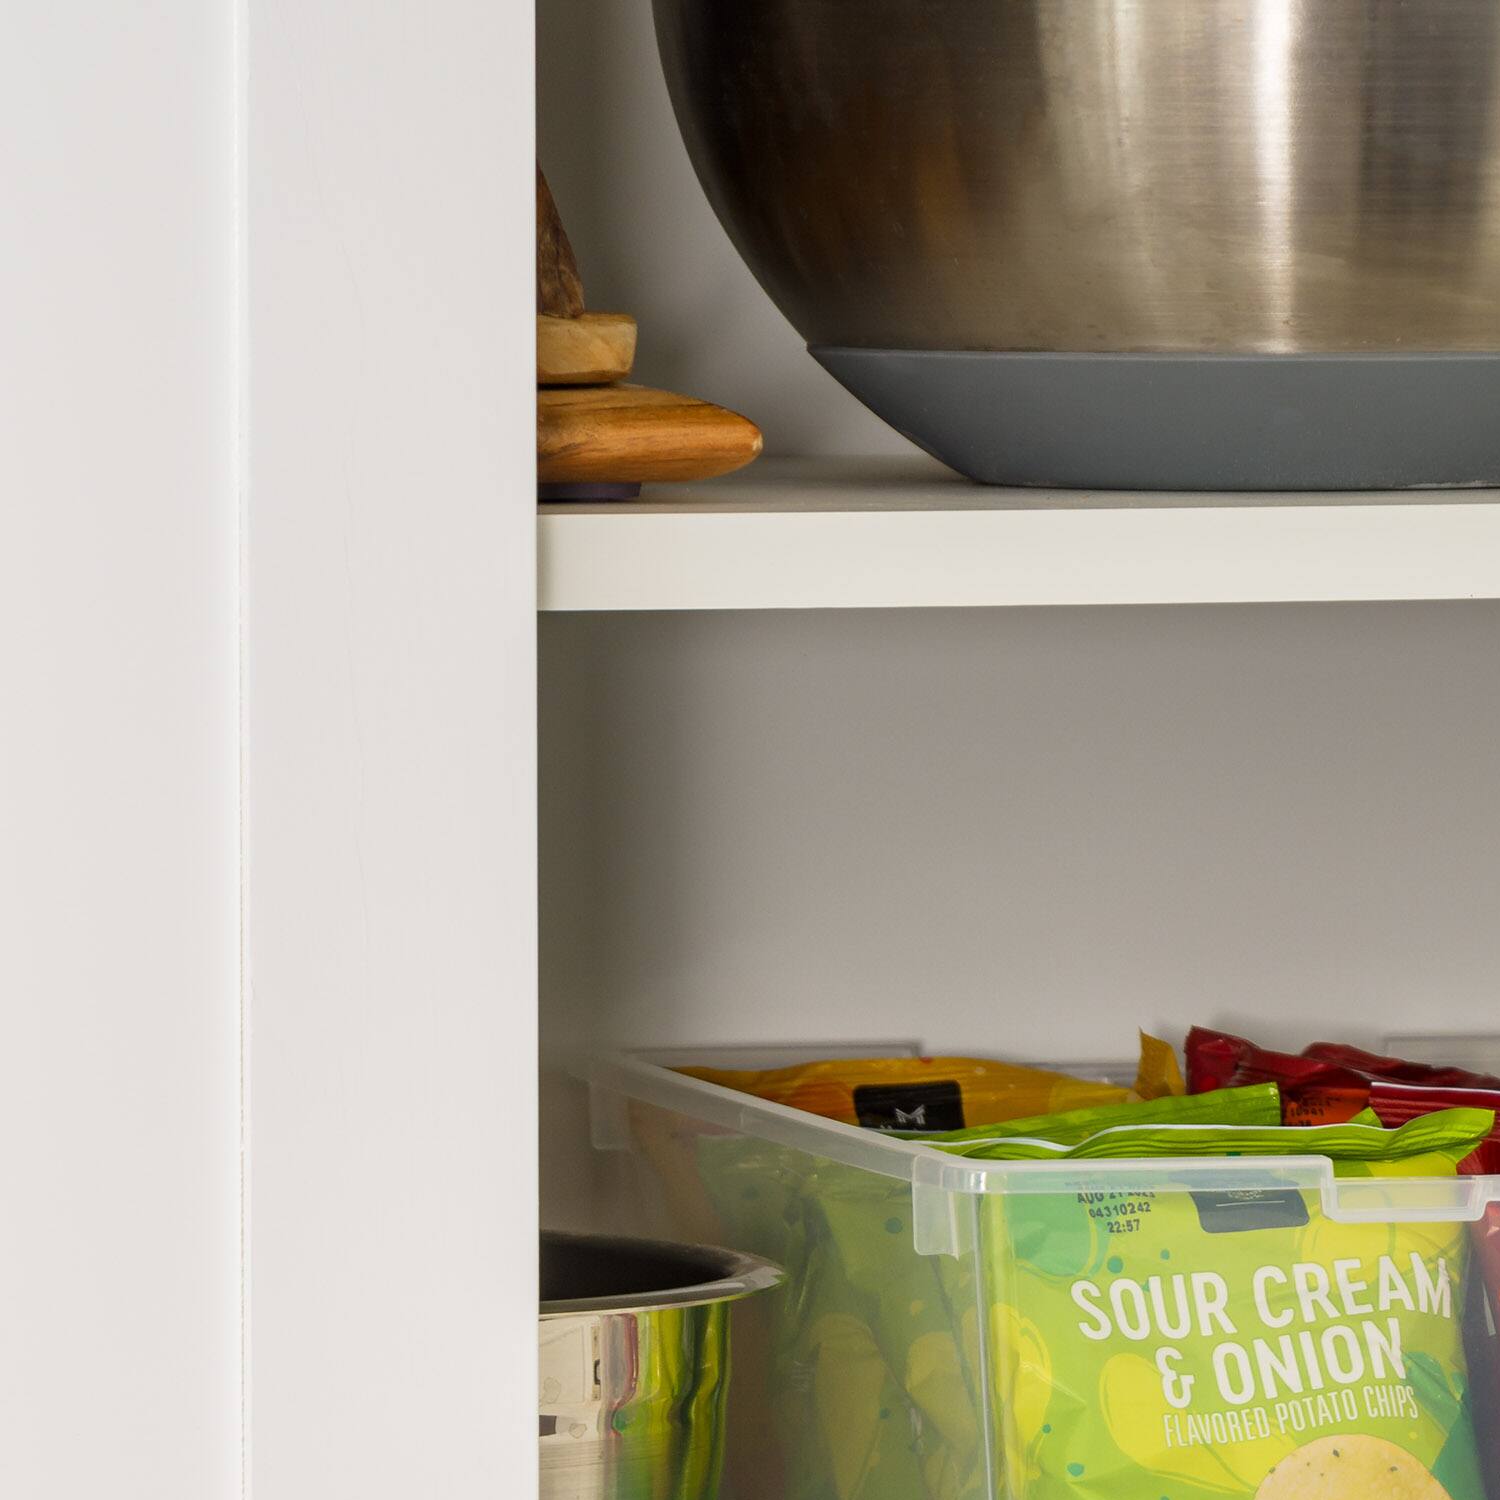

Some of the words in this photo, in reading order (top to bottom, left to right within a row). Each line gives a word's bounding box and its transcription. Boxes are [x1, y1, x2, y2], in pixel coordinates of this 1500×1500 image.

[1088, 1202, 1152, 1218] 04310242
[1107, 1219, 1141, 1233] 22:57
[1069, 1270, 1238, 1342] SOUR
[1251, 1251, 1452, 1329] CREAM
[1154, 1346, 1196, 1409] &
[1211, 1317, 1407, 1406] ONION
[1162, 1407, 1271, 1449] FLAVORED
[1275, 1388, 1359, 1433] POTATO
[1364, 1383, 1420, 1420] CHIPS
